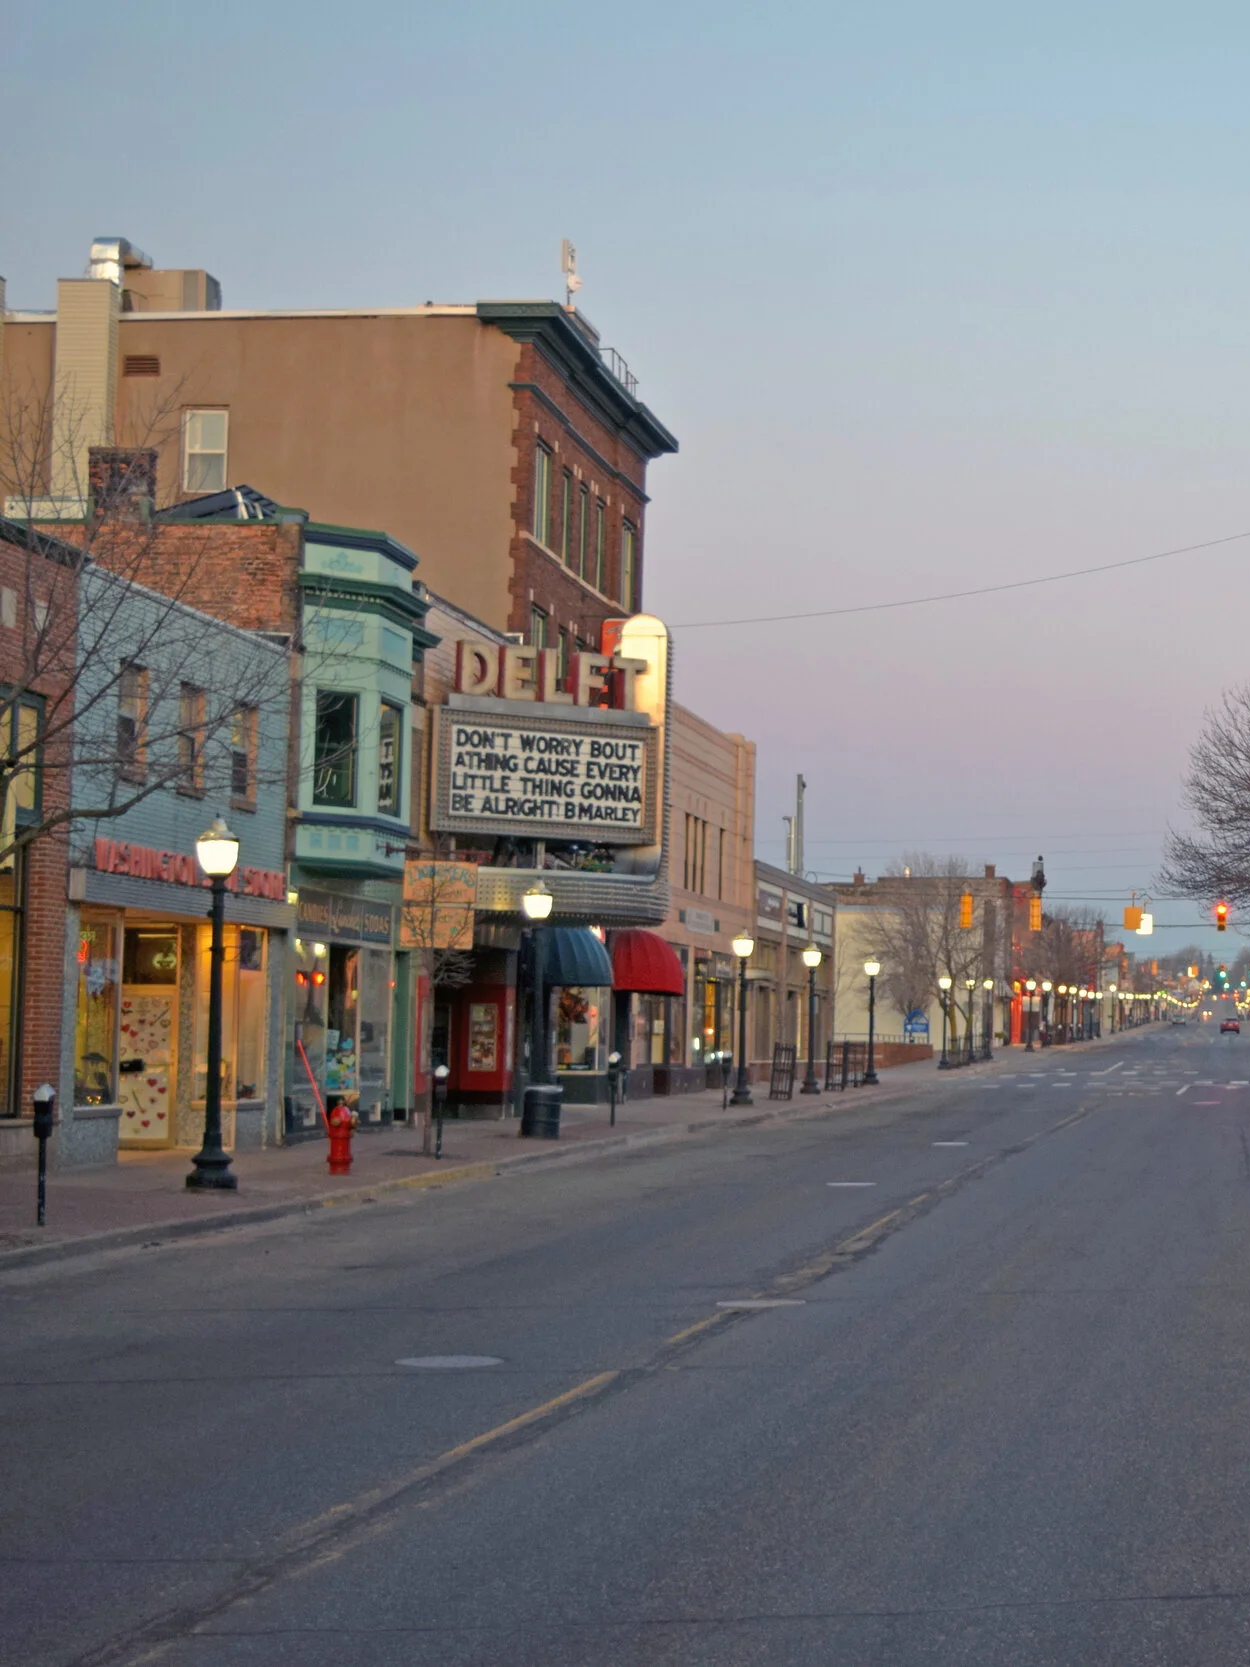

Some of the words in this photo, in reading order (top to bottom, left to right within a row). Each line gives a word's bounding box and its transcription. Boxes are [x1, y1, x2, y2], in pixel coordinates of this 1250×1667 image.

[455, 639, 648, 709] DELFT
[456, 728, 512, 750] DON'T
[520, 733, 584, 757] WORRY
[590, 740, 640, 762] BOUT
[524, 756, 580, 778] CAUSE
[586, 761, 641, 783] EVERY
[451, 793, 475, 812] BE
[452, 771, 511, 794] LITTLE
[520, 777, 575, 798] THING
[580, 781, 642, 804] GONNA
[95, 837, 199, 887] WASHINGTON
